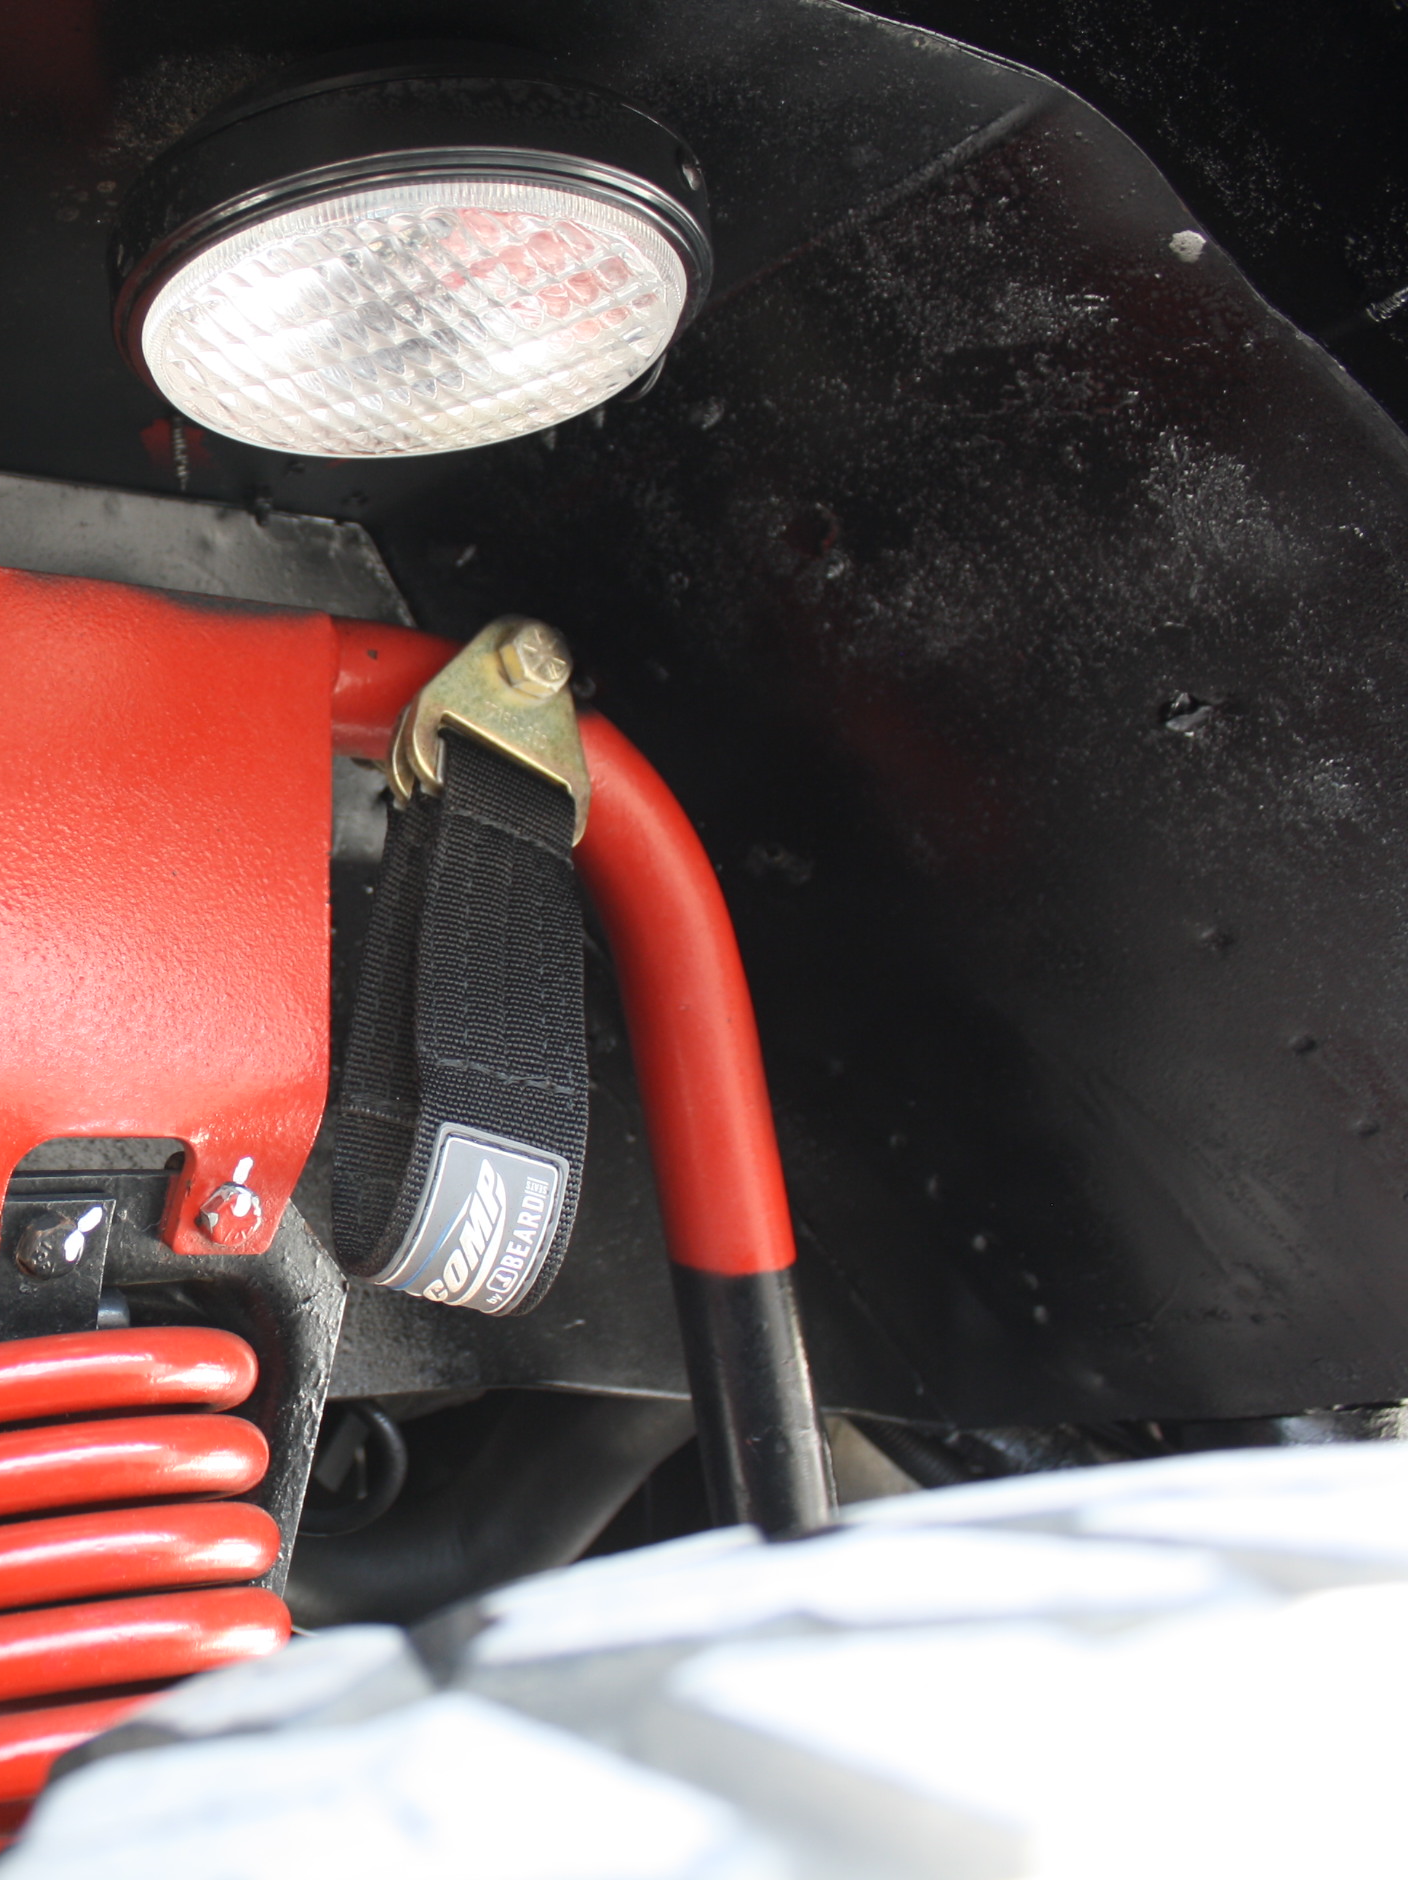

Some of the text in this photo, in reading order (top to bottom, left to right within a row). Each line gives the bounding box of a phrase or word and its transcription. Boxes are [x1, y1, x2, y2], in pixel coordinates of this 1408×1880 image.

[423, 1159, 500, 1301] COMP
[525, 1180, 549, 1196] SEATS
[485, 1195, 545, 1305] by BEARD
